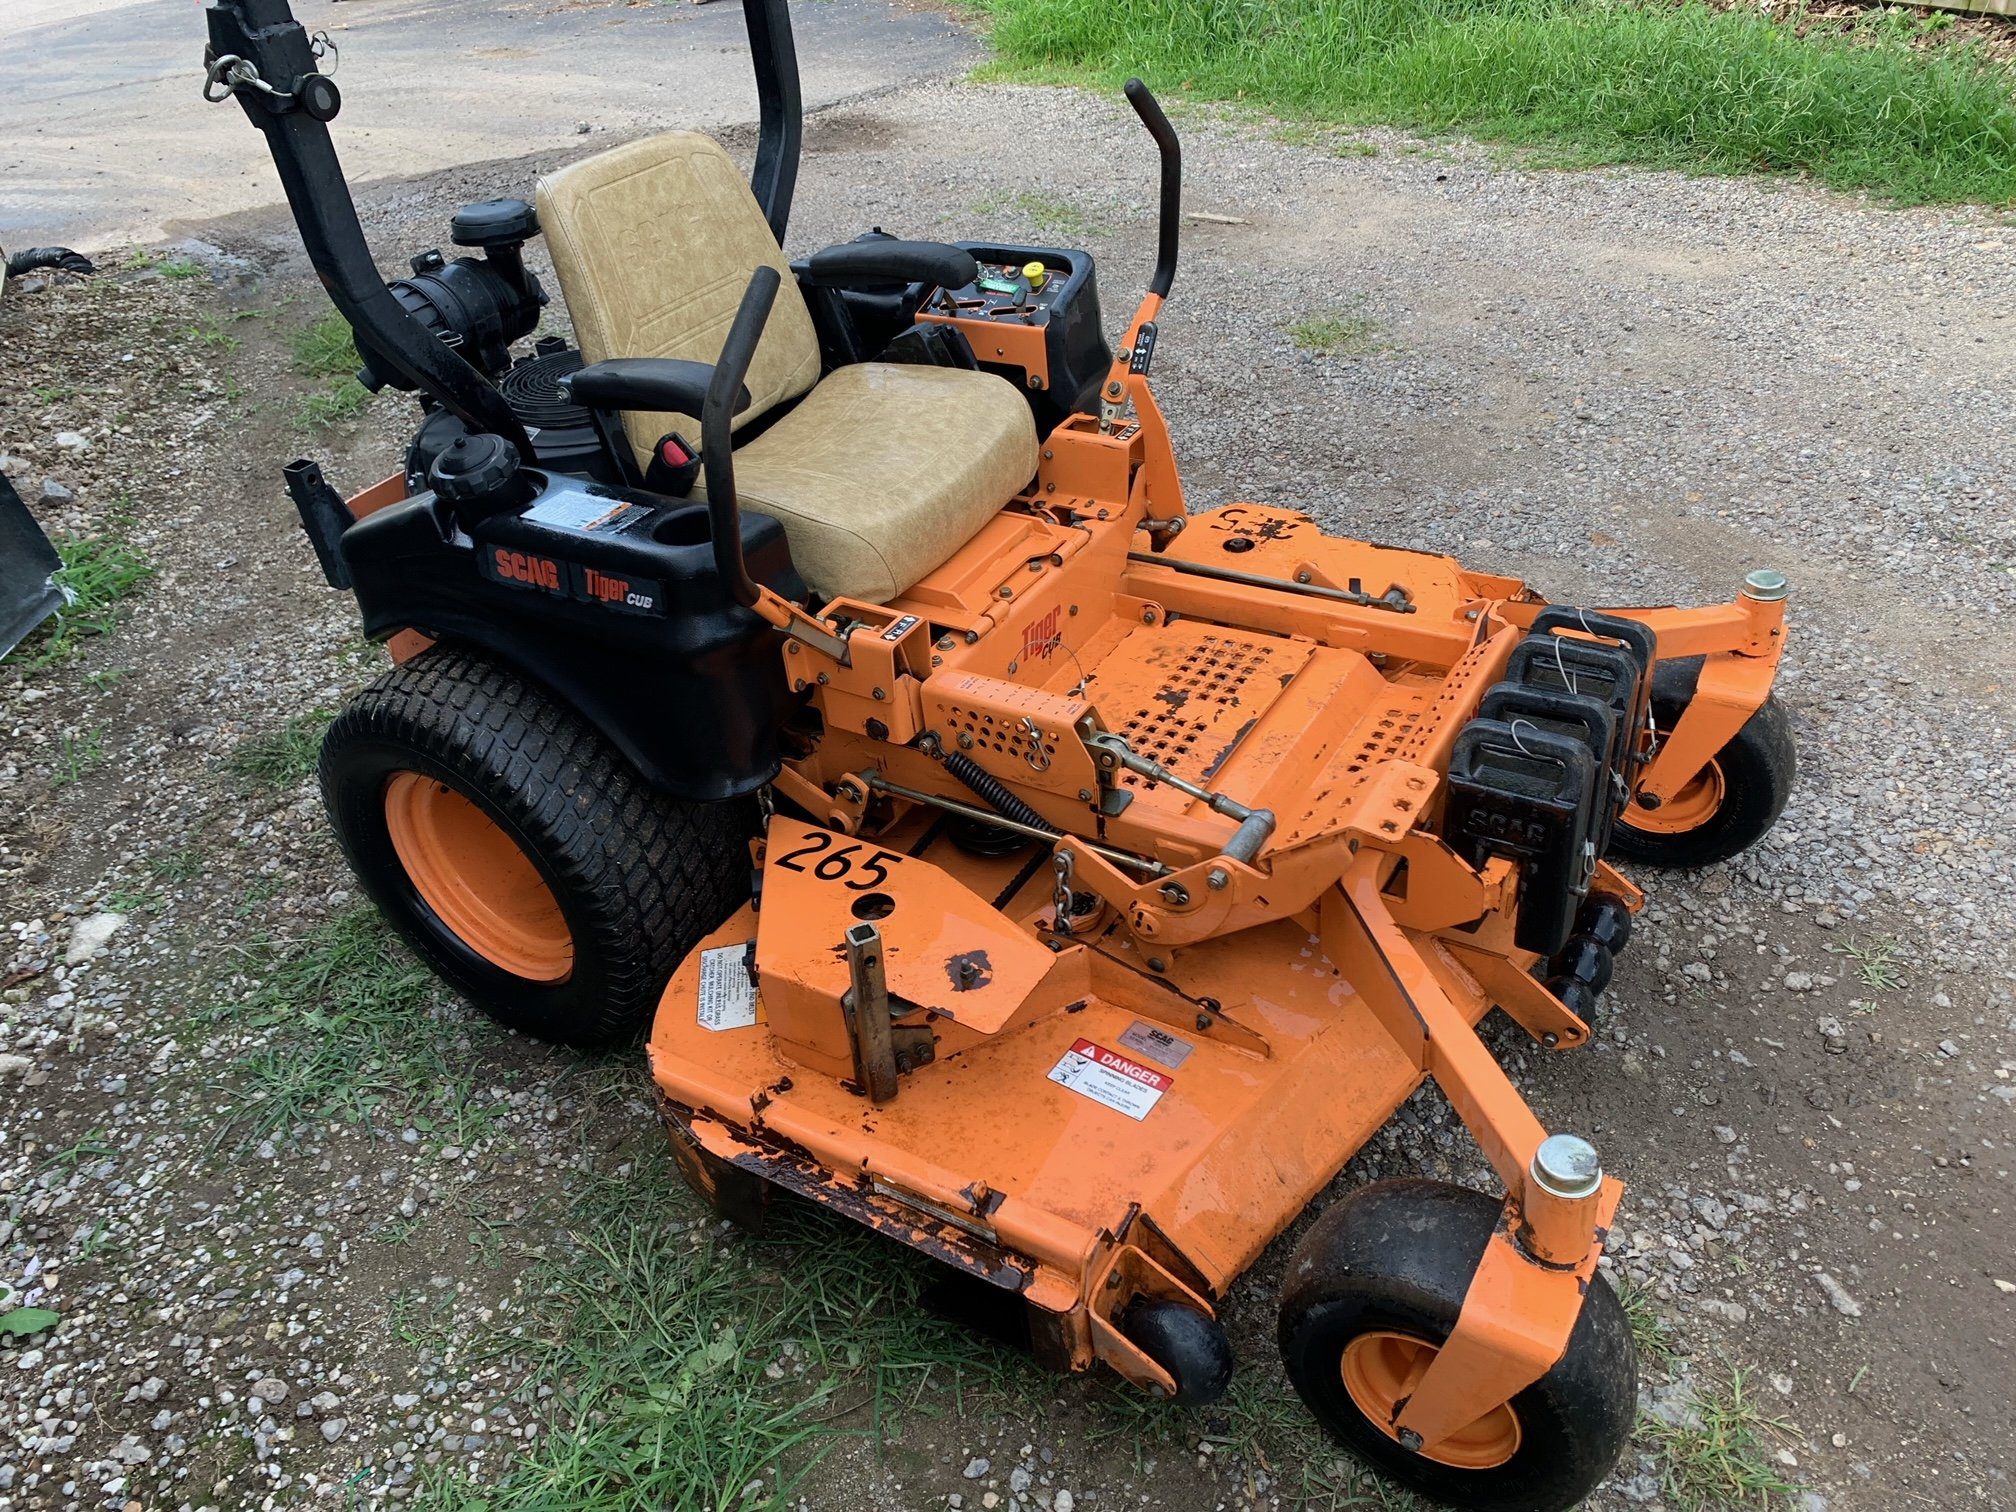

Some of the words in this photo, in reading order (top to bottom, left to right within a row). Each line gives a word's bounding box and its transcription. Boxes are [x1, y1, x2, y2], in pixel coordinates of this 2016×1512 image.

[495, 549, 558, 588] SCAG
[584, 568, 629, 602] Tiger
[626, 593, 653, 608] CUB
[1022, 605, 1061, 662] Tiger
[1041, 631, 1062, 660] CUB
[1468, 809, 1546, 842] SCAG
[774, 832, 903, 890] 265
[1149, 1030, 1174, 1044] SCAG
[1100, 1054, 1160, 1086] DANGER
[1100, 1068, 1125, 1085] SPINNING
[1125, 1079, 1148, 1094] BLADES
[1104, 1081, 1116, 1089] KEEP
[1116, 1086, 1130, 1095] CLEAR
